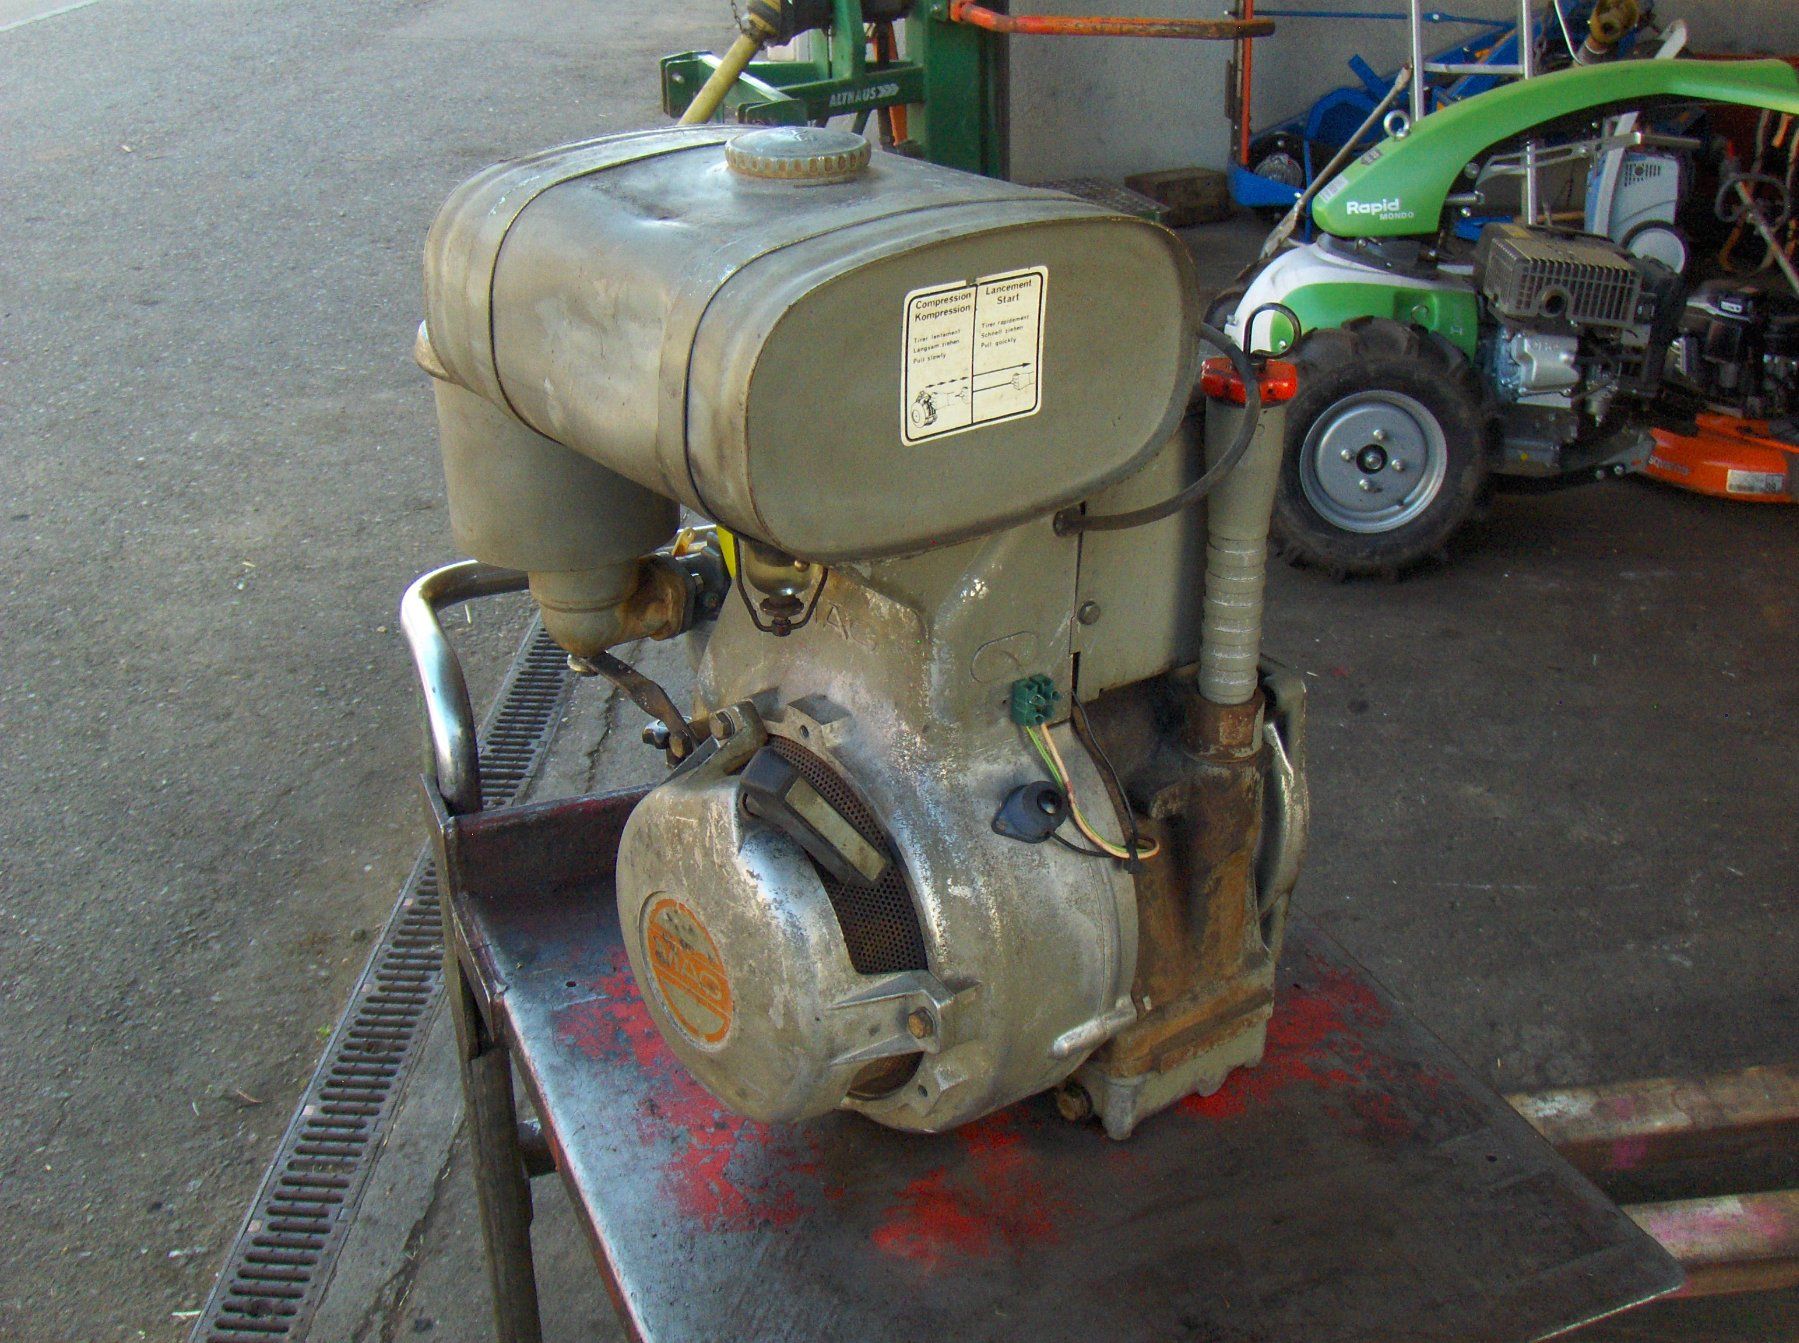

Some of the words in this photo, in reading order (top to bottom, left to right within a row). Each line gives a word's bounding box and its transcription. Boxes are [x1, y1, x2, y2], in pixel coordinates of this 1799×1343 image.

[829, 86, 877, 107] ALTHAUS
[1346, 198, 1400, 216] Rapid
[1379, 212, 1414, 221] MONDO
[986, 279, 1032, 296] Lancement
[915, 292, 972, 310] Compression
[997, 293, 1020, 305] Start
[914, 304, 971, 322] Kompression
[981, 320, 996, 329] Tirer
[980, 329, 1003, 339] Schnell
[1005, 325, 1024, 334] ziehen
[913, 342, 940, 354] Langsam
[941, 338, 960, 348] ziehen
[914, 336, 928, 344] Tirer
[980, 341, 992, 349] Pull
[913, 357, 925, 365] Pull
[927, 353, 947, 363] slowly
